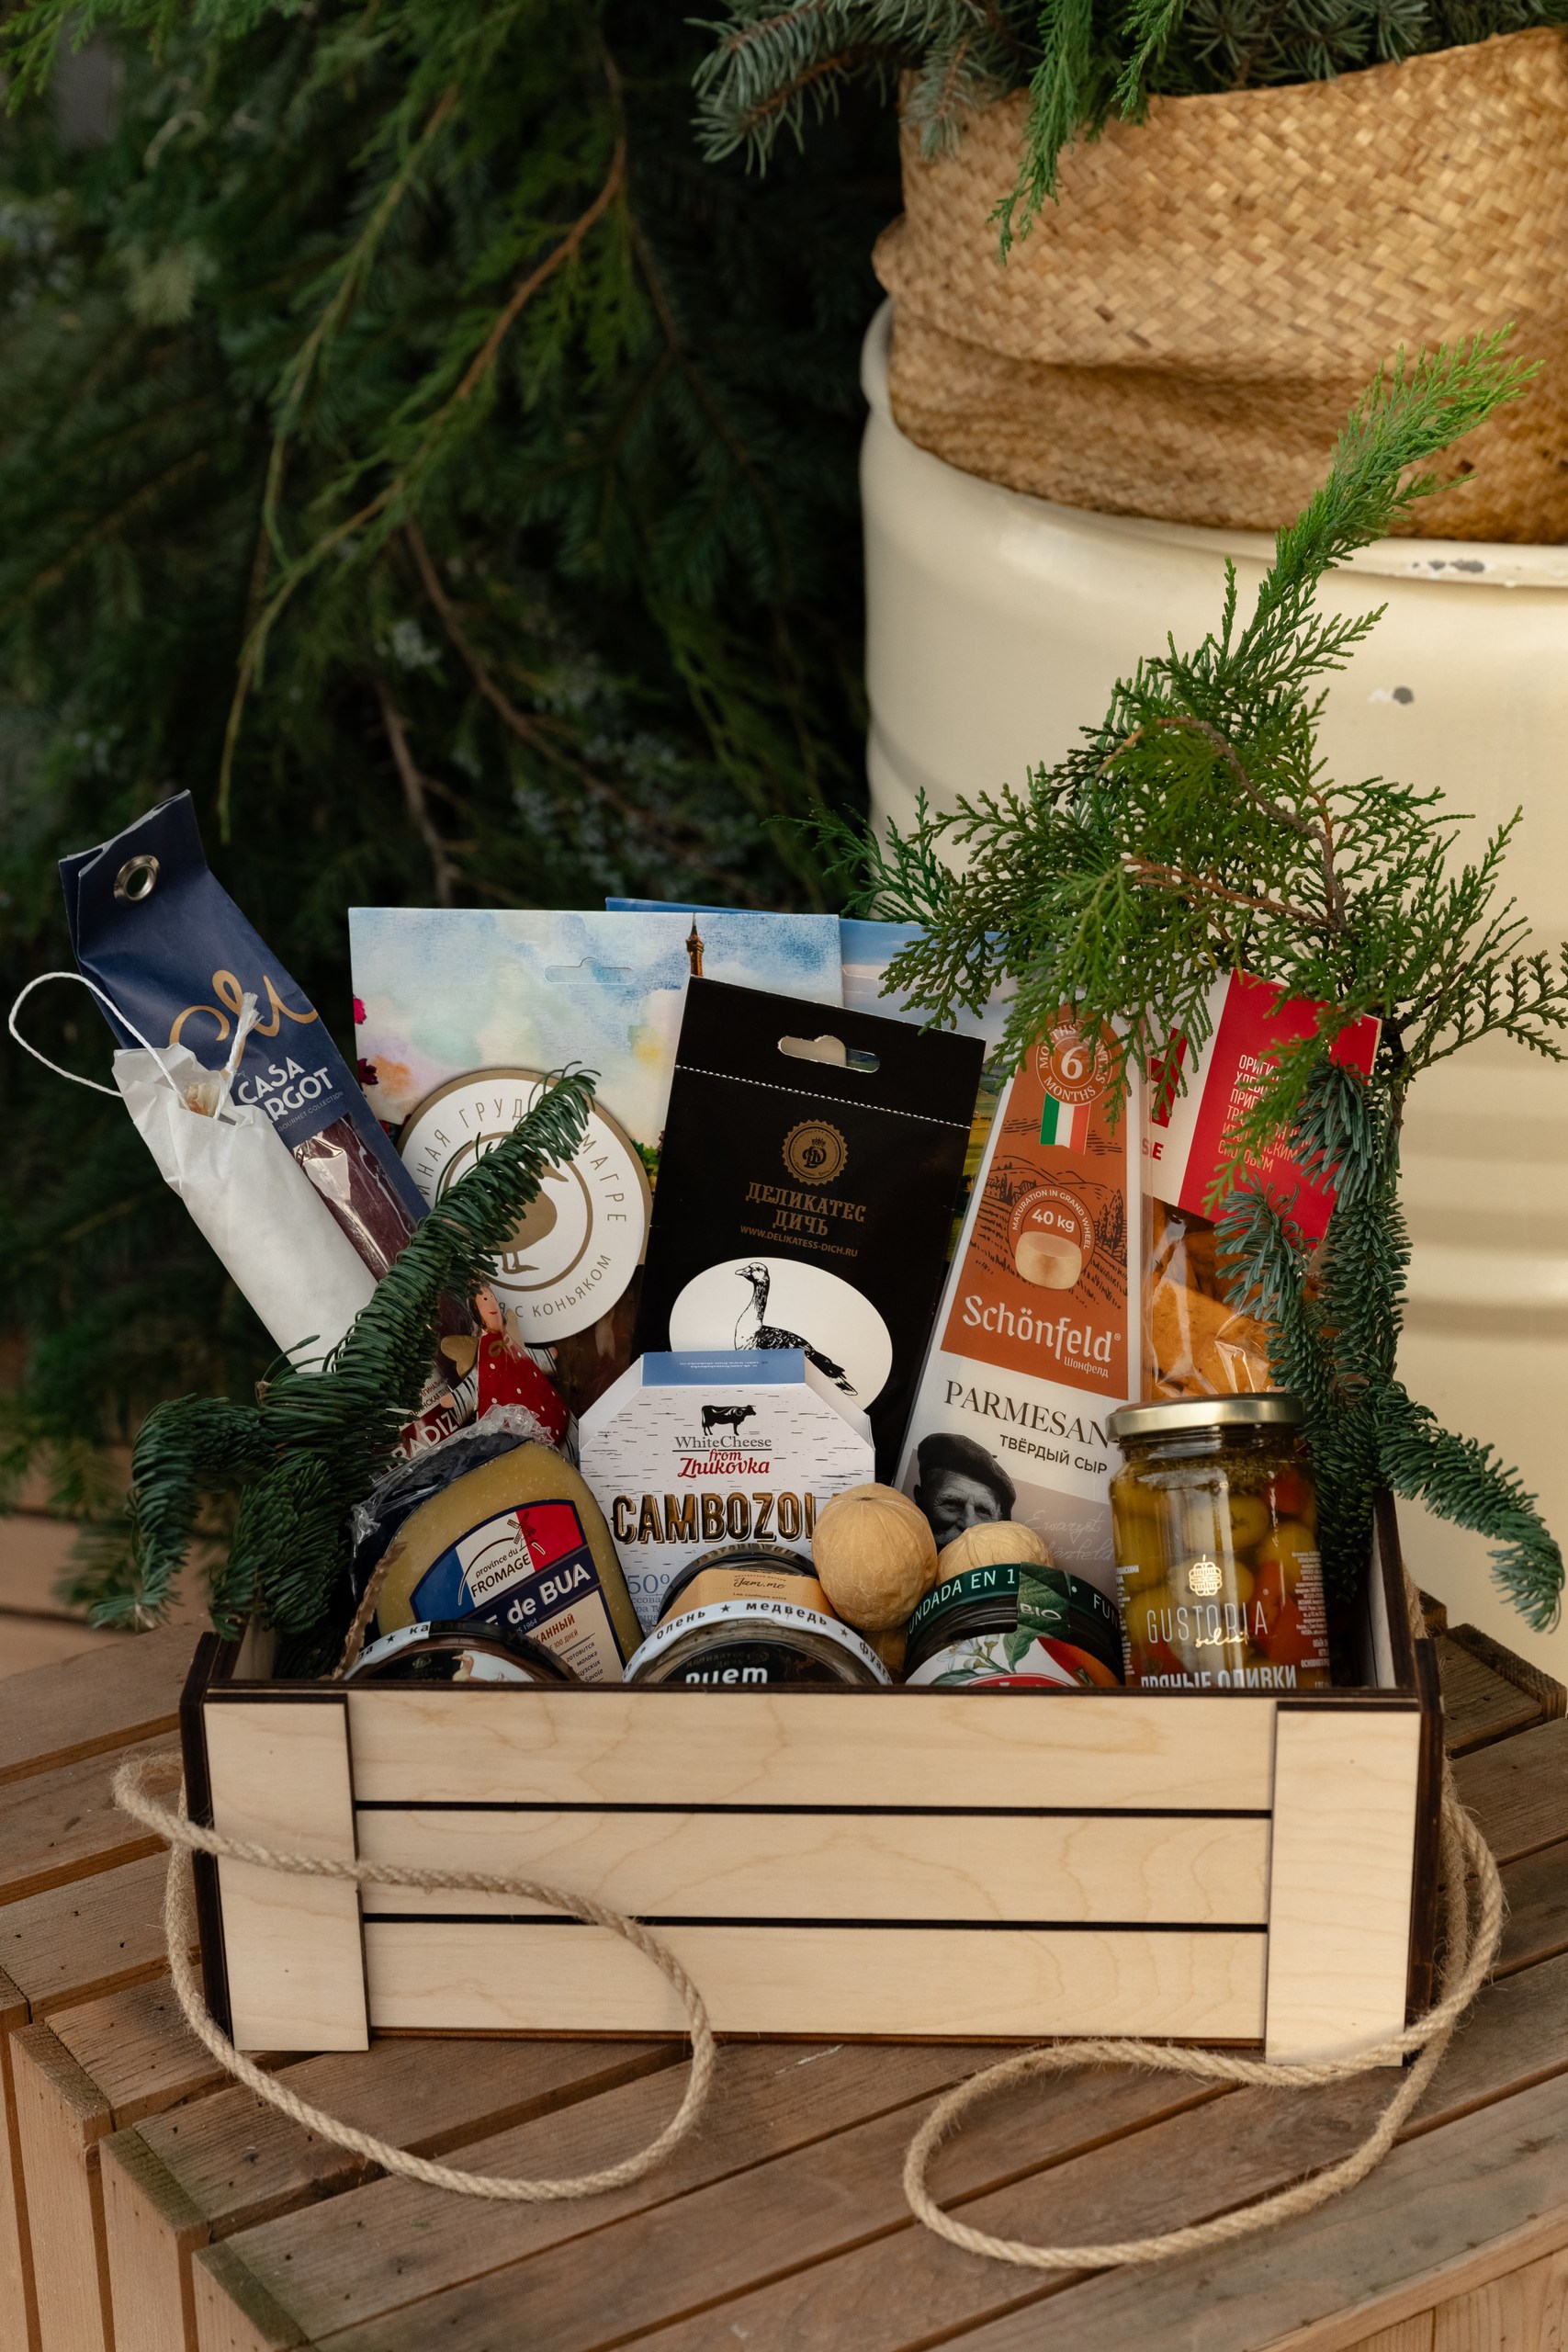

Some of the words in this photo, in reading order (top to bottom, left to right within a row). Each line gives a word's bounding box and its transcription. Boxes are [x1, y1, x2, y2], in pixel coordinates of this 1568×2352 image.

[237, 1057, 306, 1104] CASA
[1060, 1046, 1084, 1080] 6
[264, 1067, 334, 1122] RGOT
[1043, 1075, 1097, 1102] MONTHS
[277, 1110, 309, 1133] GOURMET
[307, 1090, 344, 1115] COLLECTION
[417, 1128, 452, 1197] ИНАЯ
[459, 1097, 523, 1128] ГРУД
[579, 1133, 627, 1222] МАГРЕ
[745, 1182, 867, 1223] ДЕЛИКАТЕС
[1012, 1189, 1048, 1231] MATURATION
[1049, 1189, 1058, 1197] IN
[1059, 1192, 1085, 1216] GRAND
[1082, 1216, 1092, 1250] WHEEL
[773, 1209, 829, 1237] ДИЧЬ
[1032, 1208, 1055, 1226] 40
[1056, 1215, 1076, 1233] kg
[739, 1225, 859, 1258] WWW.DELIKATESS-DICH.RU
[532, 1254, 613, 1318] КОНЬЯКОМ
[962, 1295, 1113, 1363] Schönfeld
[1064, 1355, 1110, 1379] Шонфелд
[942, 1379, 1109, 1450] PARMESAN
[675, 1435, 773, 1449] WhiteCheese
[709, 1448, 742, 1462] from
[999, 1433, 1070, 1465] ТВЁРДЫЙ
[1074, 1456, 1109, 1475] СЫР
[677, 1457, 771, 1479] Zhukovka
[470, 1553, 532, 1599] FROMAGE
[475, 1554, 508, 1578] province
[507, 1547, 519, 1559] du
[506, 1596, 536, 1625] de
[538, 1563, 592, 1606] BUA
[733, 1577, 787, 1589] Jam.me
[908, 1578, 963, 1635] UNDADA
[970, 1569, 997, 1589] EN
[1020, 1602, 1063, 1621] BIO
[1092, 1592, 1120, 1628] FUN
[523, 1617, 538, 1633] 1964
[564, 1628, 580, 1643] ДНЕЙ
[656, 1609, 706, 1641] олень
[745, 1600, 828, 1627] медведь
[1146, 1600, 1269, 1645] GUSTORIA
[576, 1650, 598, 1668] молока
[578, 1659, 601, 1677] цузских
